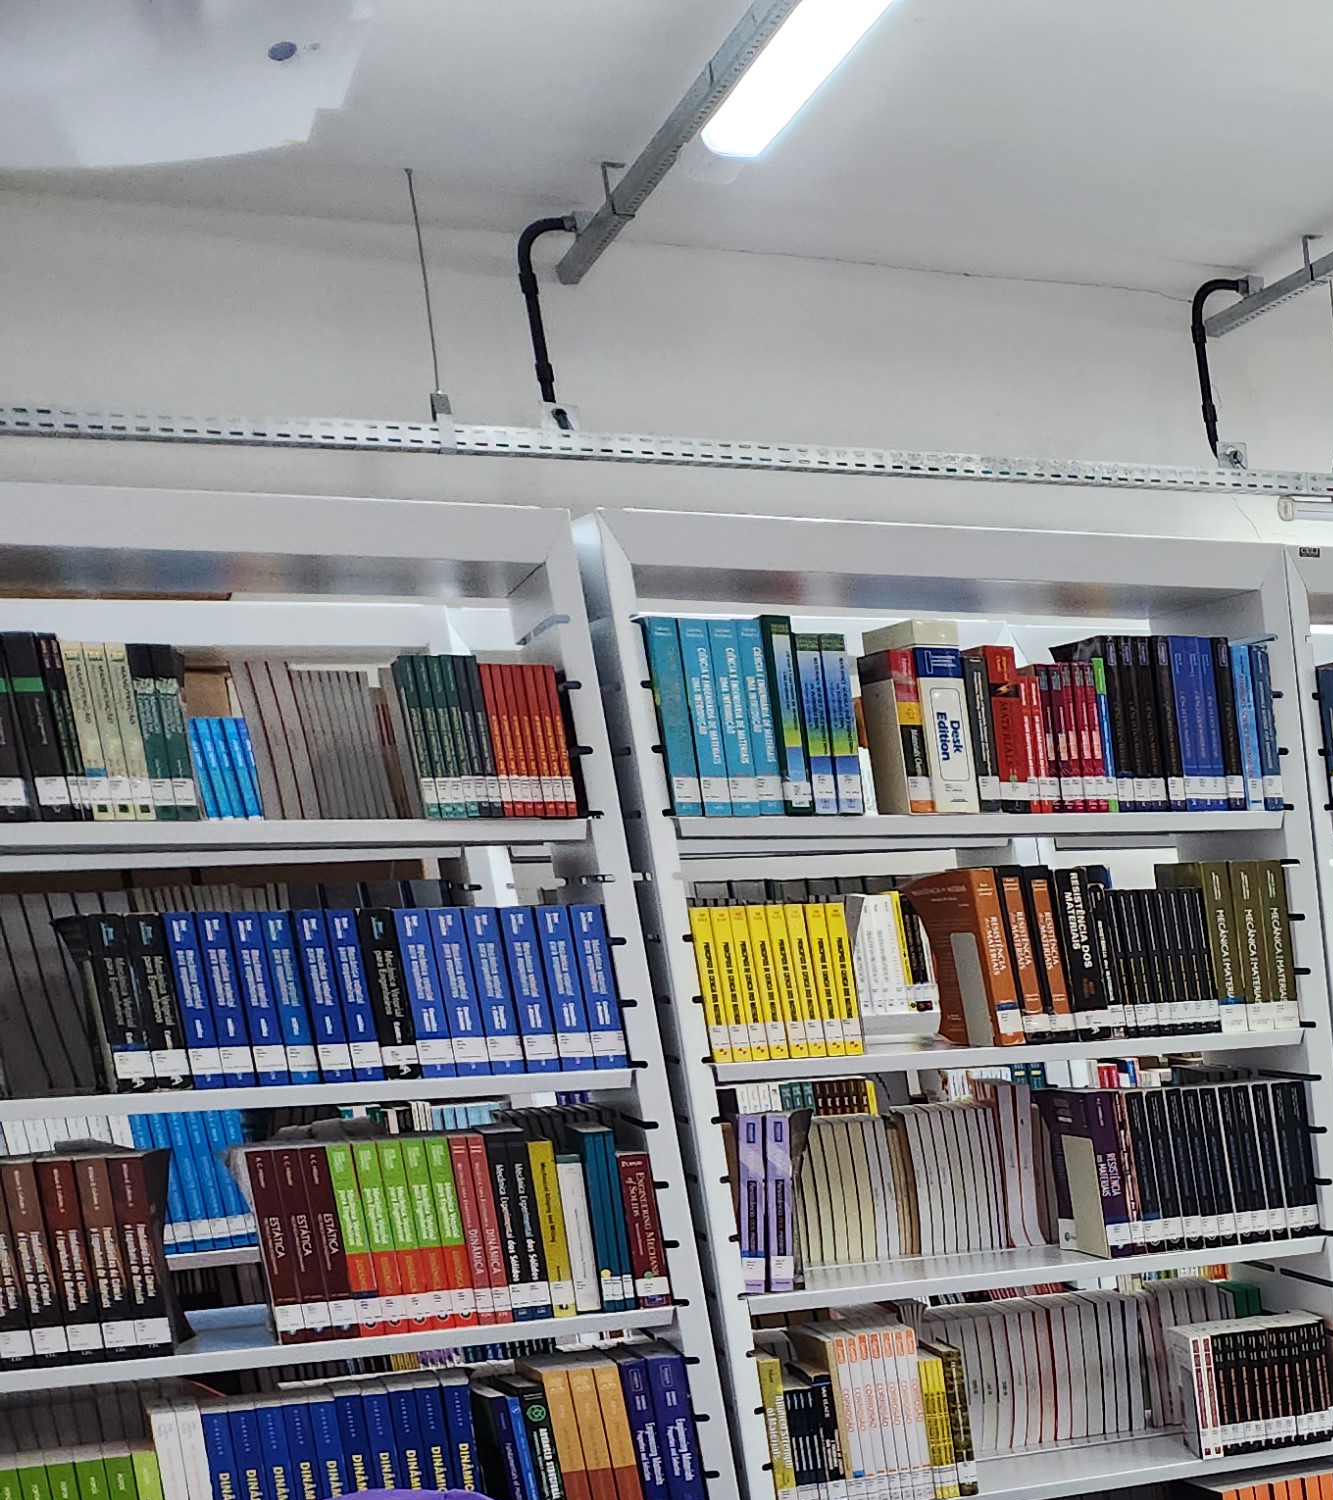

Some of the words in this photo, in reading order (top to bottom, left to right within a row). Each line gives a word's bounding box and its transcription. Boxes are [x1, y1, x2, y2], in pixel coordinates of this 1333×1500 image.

[726, 647, 738, 672] CIÊNCIA
[729, 680, 743, 718] ENGENHARIA
[736, 720, 745, 728] DE
[936, 711, 952, 761] Edition
[950, 720, 963, 753] Desk
[736, 730, 750, 763] MATERIAIS
[1043, 912, 1060, 965] RESISTÊNCIA
[1064, 892, 1079, 950] MATERIAIS
[1070, 872, 1088, 942] RESISTÊNCIA
[1082, 945, 1093, 968] DOS
[1216, 910, 1228, 957] MECÂNICA
[1244, 909, 1256, 956] MECÂNICA
[1269, 908, 1283, 954] MECÂNICA
[373, 950, 386, 967] para
[986, 930, 1000, 975] MATERIAIS
[990, 917, 1007, 970] RESISTÊNCIA
[1039, 925, 1053, 970] MATERIAIS
[142, 956, 155, 974] para
[384, 950, 398, 986] Mecânica
[147, 975, 163, 1023] Engenheiros
[154, 956, 168, 994] Mecânica
[161, 996, 175, 1025] Vetorial
[378, 969, 392, 1015] Engenheiros
[390, 988, 404, 1017] Vetorial
[495, 1165, 509, 1194] Mecânica
[514, 1164, 529, 1194] Mecânica
[626, 1177, 635, 1185] of
[1098, 1164, 1111, 1197] MATERIAIS
[1106, 1153, 1121, 1196] RESISTÊNCIA
[499, 1197, 515, 1238] Experimental
[518, 1196, 534, 1237] Experimental
[628, 1186, 640, 1217] SOLIDS
[636, 1172, 651, 1229] ENGINEERING
[269, 1217, 286, 1258] ESTÁTICA
[296, 1215, 313, 1256] ESTÁTICA
[323, 1213, 340, 1254] ESTÁTICA
[468, 1229, 484, 1275] DINÂMICA
[485, 1228, 501, 1274] DINÂMICA
[507, 1240, 517, 1253] dos
[526, 1239, 536, 1252] dos
[509, 1255, 521, 1281] Sólidos
[528, 1254, 539, 1280] Sólidos
[842, 1388, 854, 1432] CORROSÃO
[875, 1383, 888, 1427] CORROSÃO
[645, 1423, 659, 1456] Engineering
[675, 1418, 689, 1452] Engineering
[405, 1450, 422, 1490] DINÂMI
[458, 1443, 475, 1491] DINÂMIC
[651, 1458, 665, 1486] Materials
[681, 1453, 695, 1481] Materials
